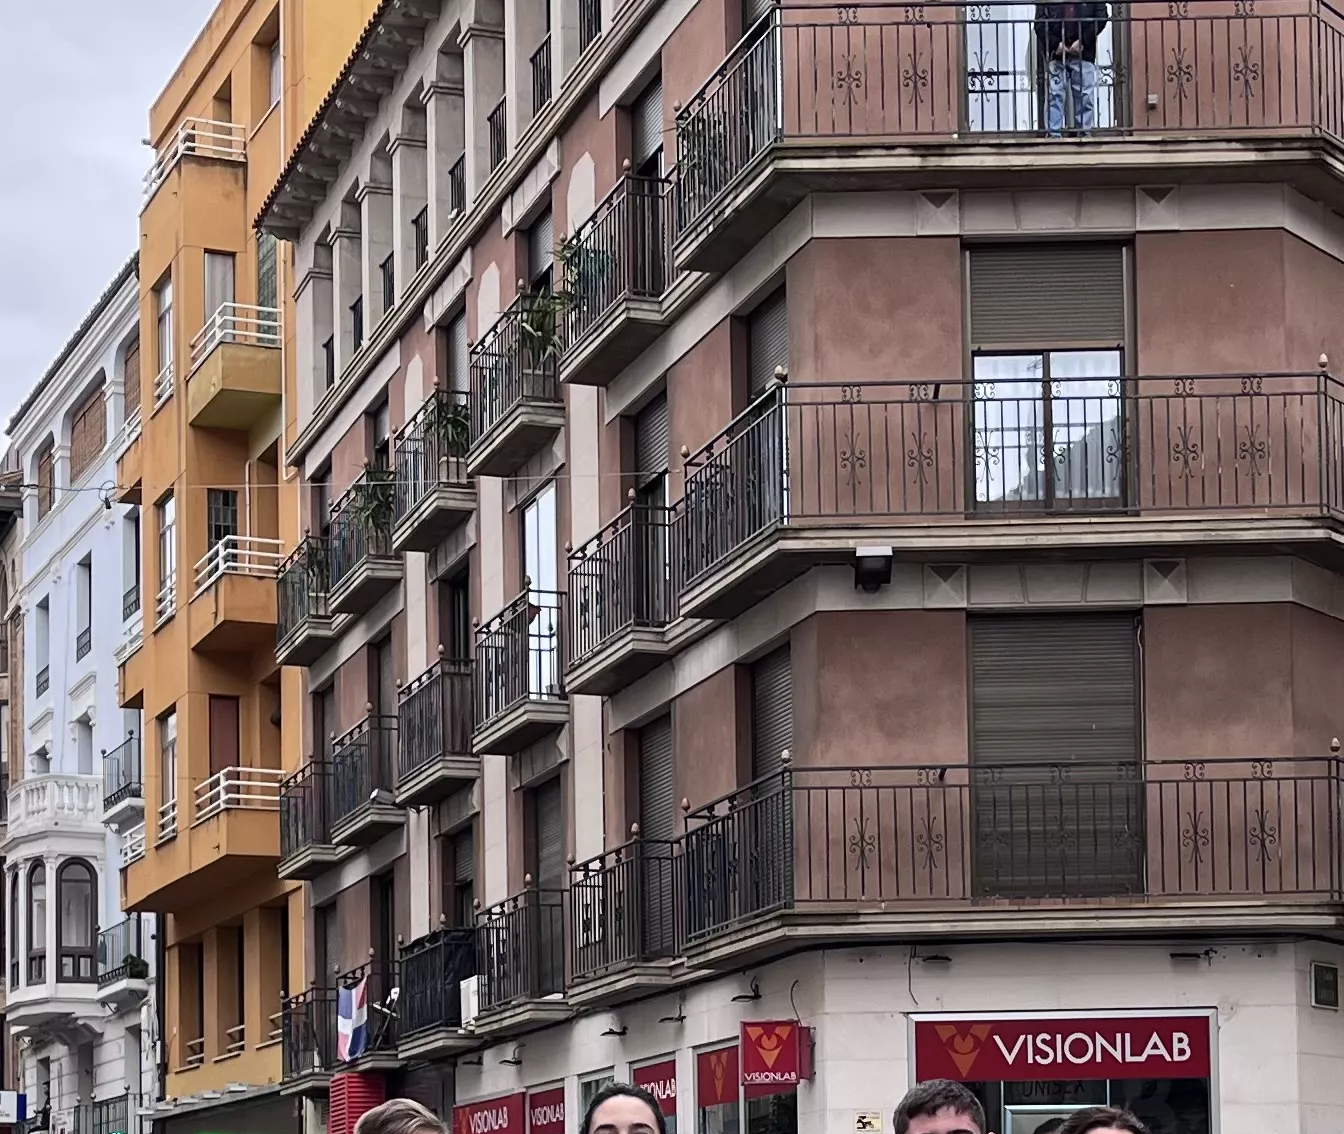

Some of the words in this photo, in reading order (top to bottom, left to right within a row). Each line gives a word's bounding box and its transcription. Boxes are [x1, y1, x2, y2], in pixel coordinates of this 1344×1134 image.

[993, 1031, 1191, 1065] VISIONLAB
[744, 1071, 797, 1081] VISIONLAB
[639, 1078, 676, 1100] IONLAB
[469, 1106, 509, 1134] VISIONLAB
[530, 1102, 565, 1127] VISIONLAB
